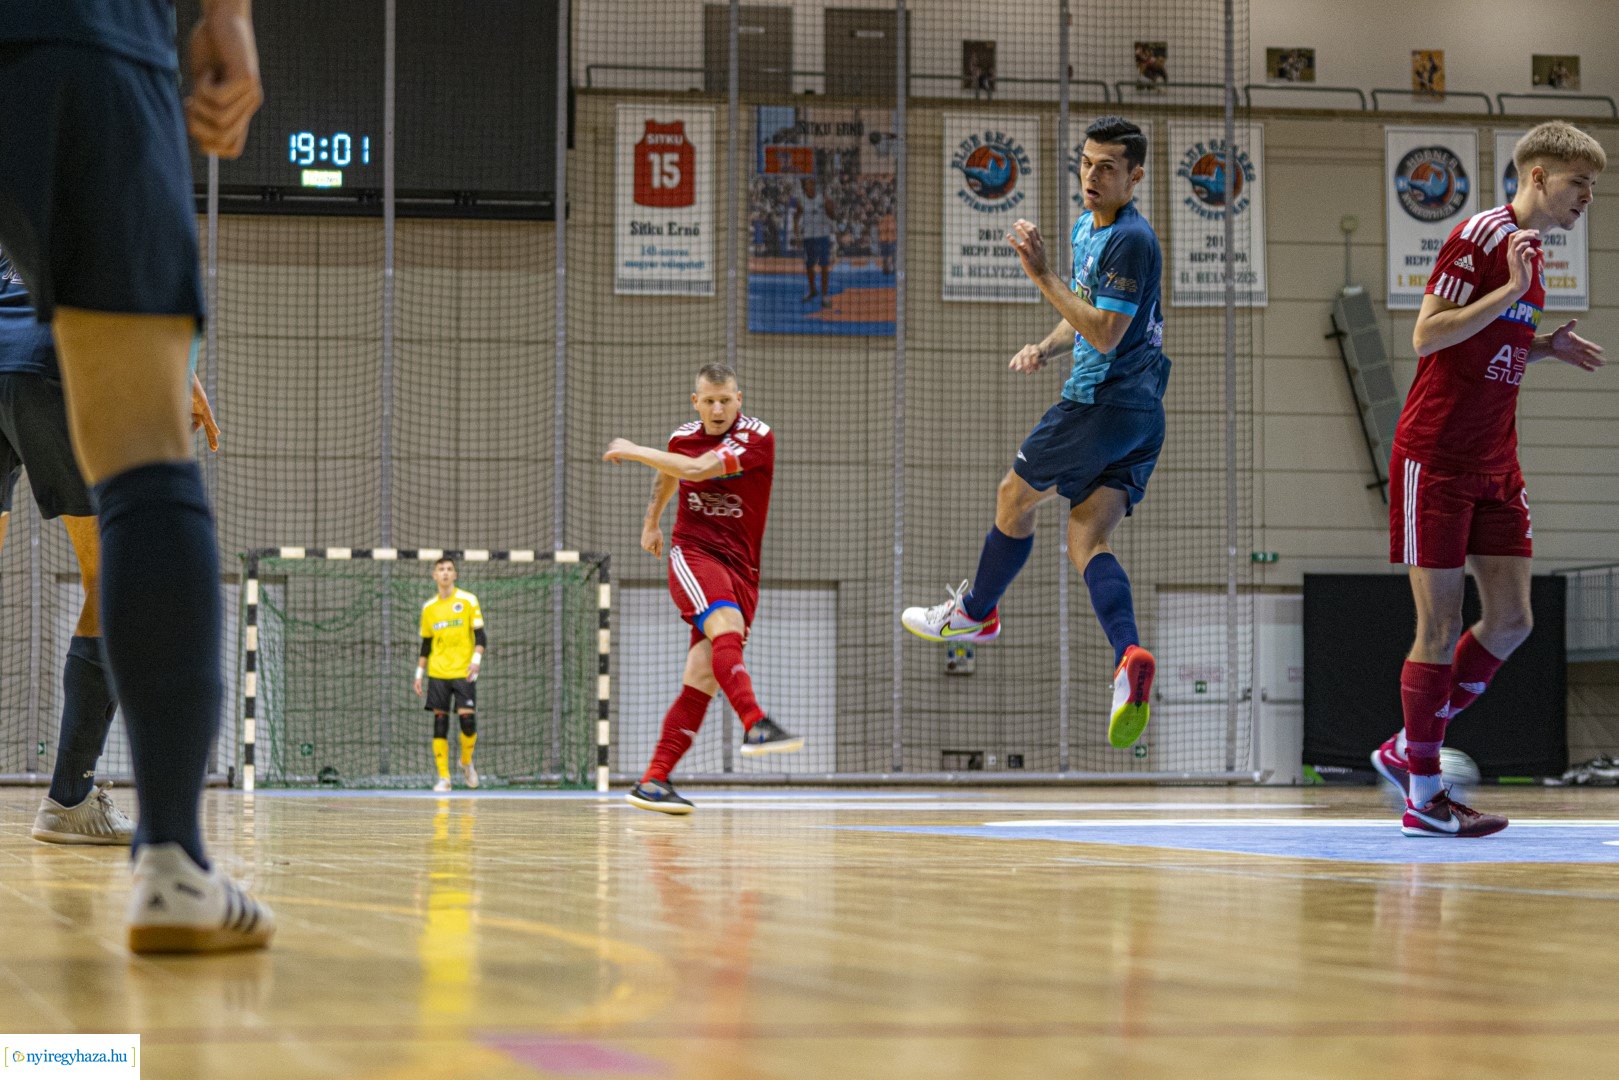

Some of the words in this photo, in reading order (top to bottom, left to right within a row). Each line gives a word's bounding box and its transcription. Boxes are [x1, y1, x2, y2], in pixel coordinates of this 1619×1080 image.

[647, 133, 684, 145] SITKU
[288, 131, 370, 167] 19:01
[950, 134, 982, 168] BLUE
[985, 129, 1032, 175] SHARKS
[647, 152, 682, 188] 15
[630, 219, 663, 236] Sitku
[668, 221, 700, 236] Ernő
[978, 228, 1005, 241] 2017
[1544, 234, 1567, 246] 2021
[1206, 235, 1224, 248] 201
[1189, 252, 1218, 263] HEPP
[1220, 252, 1248, 263] KPA
